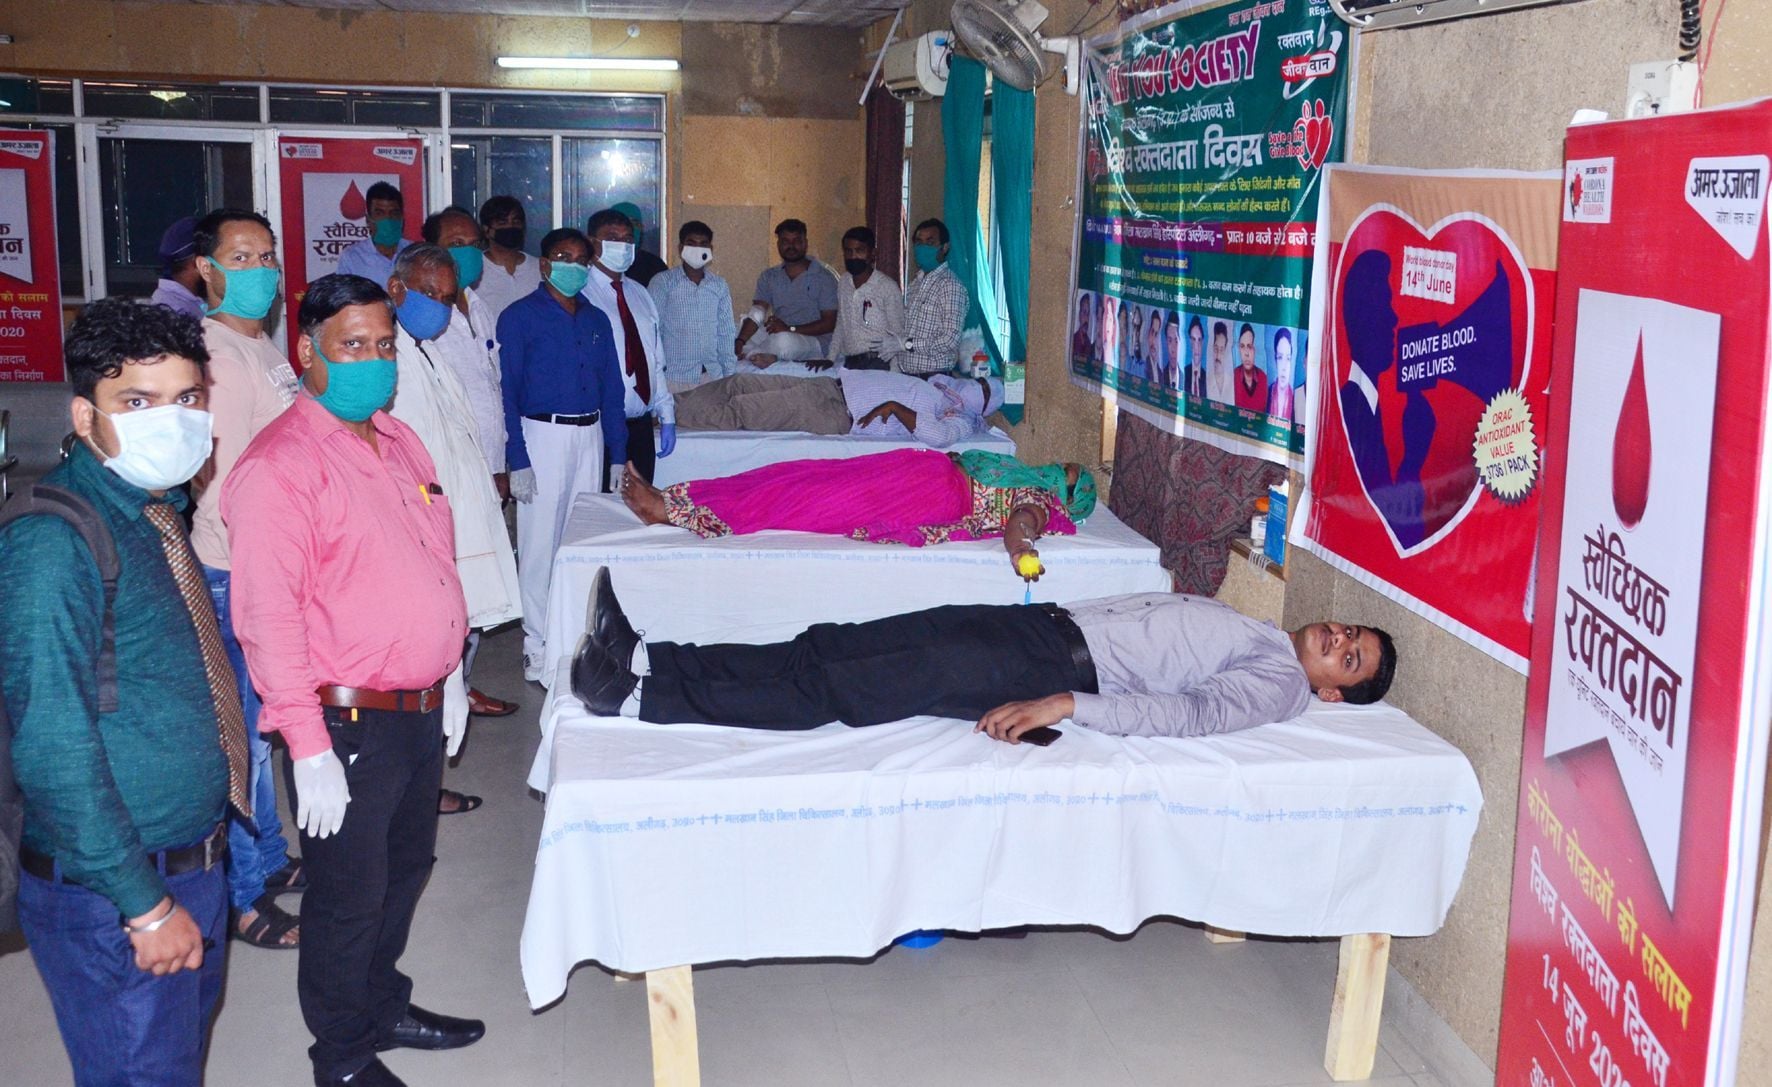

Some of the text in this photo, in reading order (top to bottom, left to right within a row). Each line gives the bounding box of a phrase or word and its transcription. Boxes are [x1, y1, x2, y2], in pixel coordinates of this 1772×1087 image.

[1277, 30, 1314, 49] रक्तदान
[1168, 20, 1261, 93] SOCIETY
[1224, 96, 1235, 118] से
[1134, 139, 1198, 173] रक्तदाता
[1203, 124, 1265, 169] दिवस
[1690, 168, 1760, 199] अमर उजाला
[323, 222, 369, 239] स्वैच्छि
[1256, 227, 1271, 244] बजे
[1288, 228, 1308, 246] बजे
[1406, 270, 1451, 294] 14th June
[18, 293, 48, 302] सलाम
[11, 305, 42, 320] दिवस
[0, 327, 25, 337] 020
[1402, 326, 1477, 360] DONATE BLOOD.
[1401, 356, 1457, 383] SAVE LIVES.
[1492, 408, 1512, 425] ORAC
[1478, 420, 1525, 446] ANTIOXIDANT
[1490, 442, 1515, 459] VALUE
[1486, 463, 1504, 480] 3736
[1507, 454, 1530, 474] PACK
[1583, 524, 1670, 637] स्वैच्छिक
[1565, 585, 1682, 749] रक्तदान
[1527, 779, 1563, 852] कोरोना
[1617, 896, 1638, 956] को
[1641, 932, 1692, 1031] सलाम
[1530, 845, 1670, 1087] विश्व रक्तदाता दिवस
[1542, 954, 1559, 1003] 14
[1563, 982, 1588, 1053] जून
